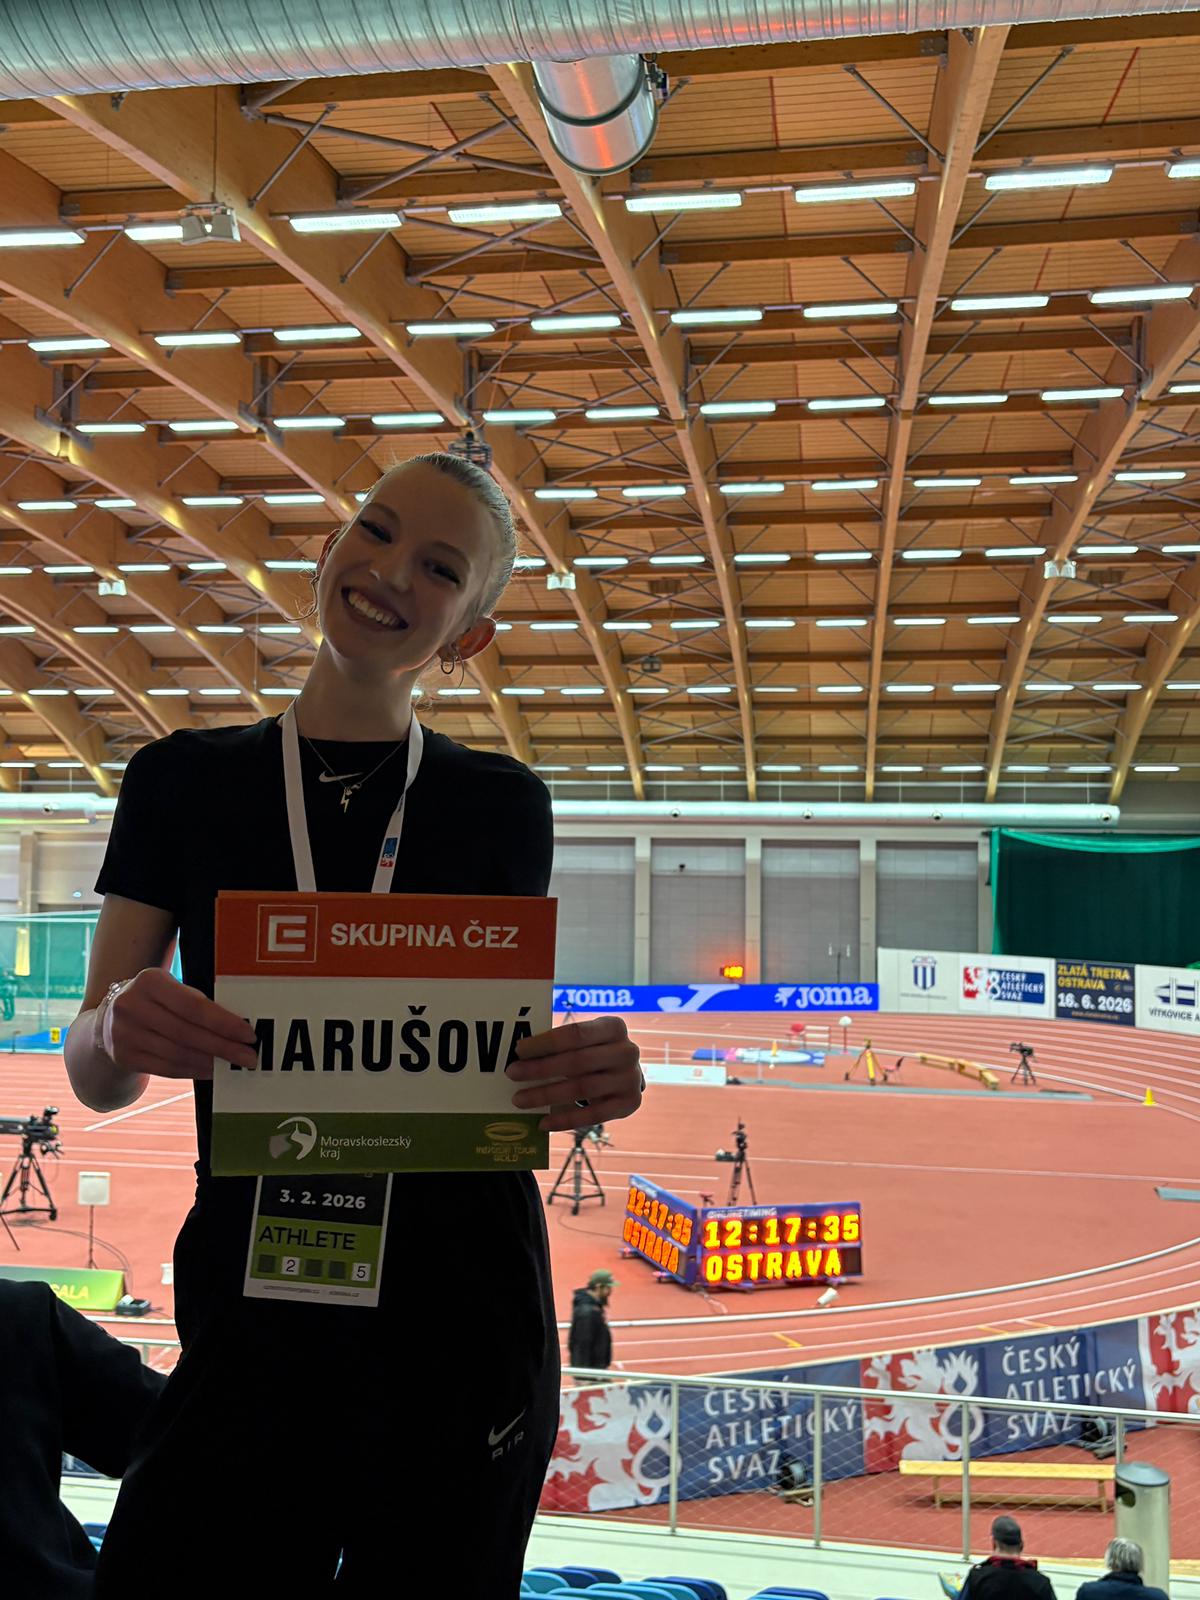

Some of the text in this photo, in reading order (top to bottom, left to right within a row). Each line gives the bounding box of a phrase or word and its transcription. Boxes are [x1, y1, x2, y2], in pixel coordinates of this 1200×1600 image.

[330, 919, 520, 949] SKUPINA ČEZ
[1057, 963, 1131, 980] ZLATÁ TRETRA
[1057, 976, 1106, 991] OSTRAVA
[1001, 991, 1023, 1001] SVAZ
[1057, 992, 1134, 1013] 16. 6. 2026
[320, 1135, 412, 1149] Moravskoslezský
[320, 1146, 341, 1161] kraj
[279, 1189, 367, 1210] 3. 2. 2026
[258, 1225, 357, 1251] ATHLETE
[623, 1216, 680, 1274] OSTRAVA
[286, 1259, 366, 1279] 2 5
[705, 1248, 841, 1282] OSTRAVA
[1002, 1335, 1081, 1377] ČESKÝ
[1006, 1358, 1137, 1402] ATLETICKÝ
[703, 1375, 790, 1417] ČESKÝ
[705, 1398, 858, 1450] ATLETICKÝ
[1007, 1409, 1074, 1440] SVAZ
[707, 1449, 782, 1485] SVAZ
